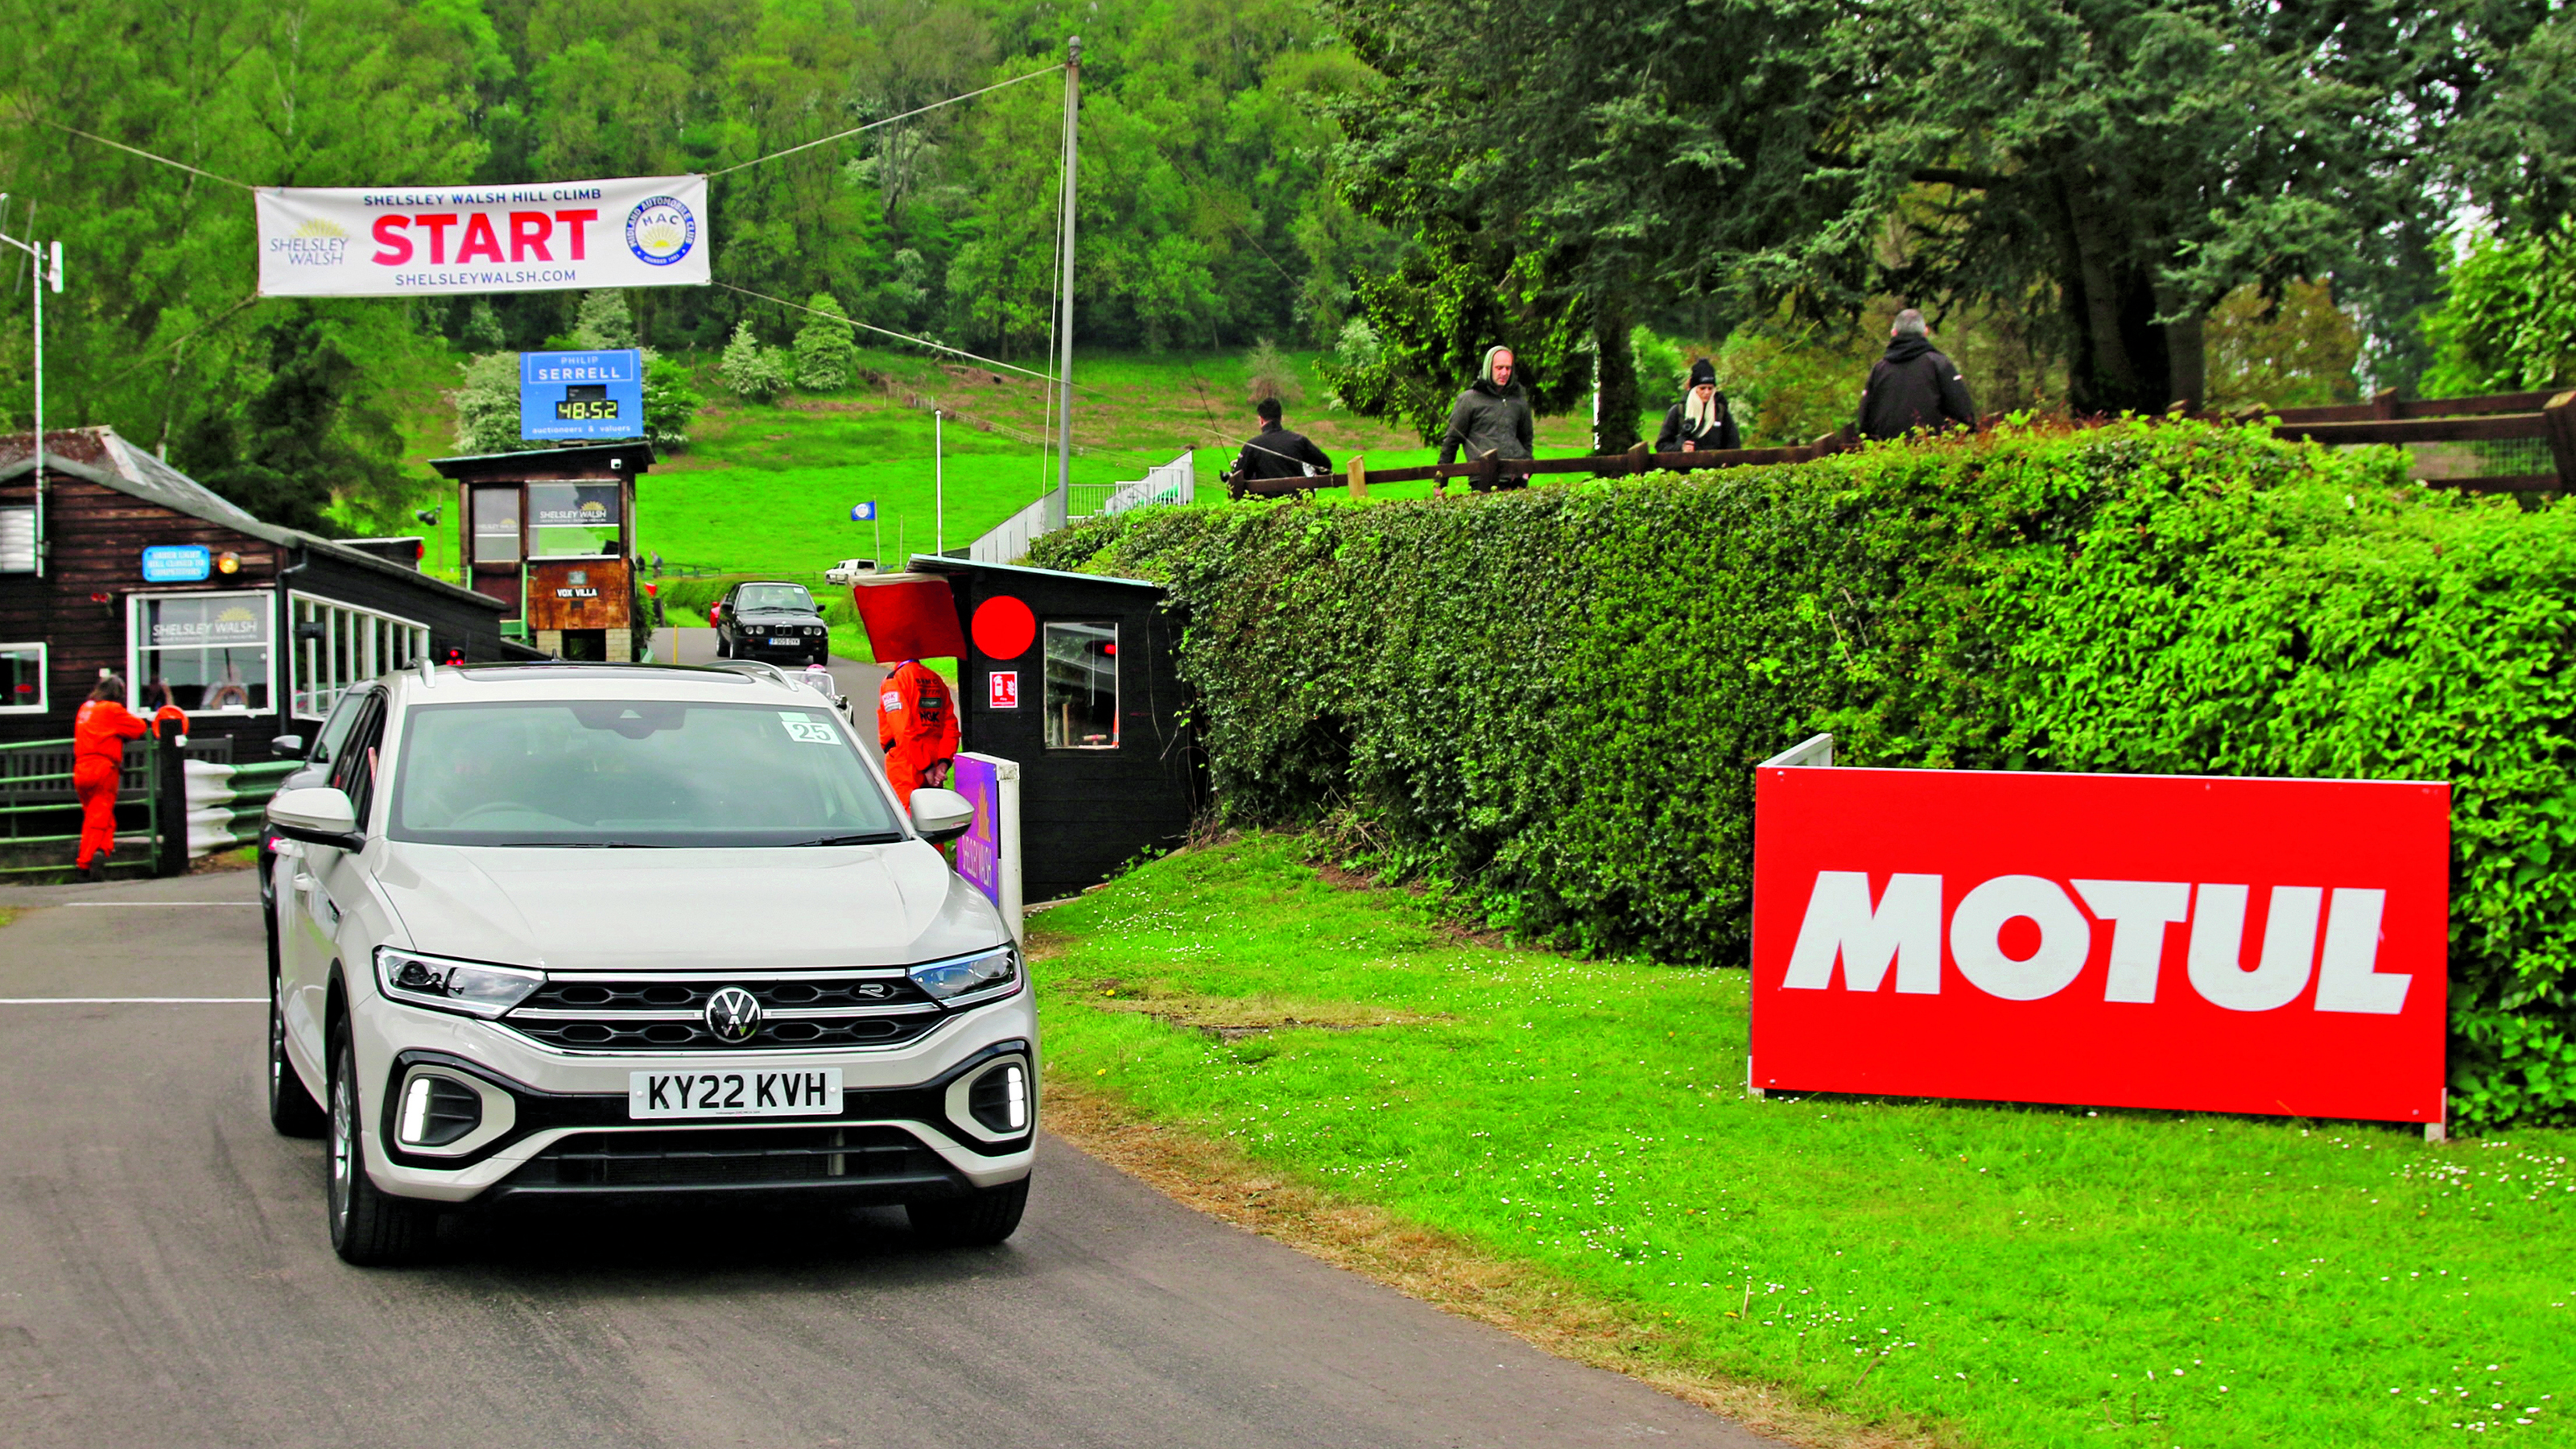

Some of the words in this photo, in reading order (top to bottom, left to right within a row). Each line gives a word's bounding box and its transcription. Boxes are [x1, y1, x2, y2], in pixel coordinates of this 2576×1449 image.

[364, 194, 444, 206] SHELSLEY
[452, 192, 506, 204] WALSH
[513, 191, 547, 202] HILL
[553, 188, 601, 200] CLIMB
[626, 208, 642, 249] MIDLAND
[642, 196, 691, 220] AUTOMOBILE
[685, 221, 695, 244] CLUB
[642, 213, 679, 226] MAC
[270, 237, 349, 252] SHELSLEY
[371, 208, 598, 266] START
[288, 251, 345, 265] WALSH
[395, 270, 576, 286] SHELSLEYWALSH.COM
[561, 356, 599, 365] PHILIP
[539, 367, 620, 380] SERRELL
[558, 402, 617, 419] 48.52
[600, 424, 631, 432] valuers
[539, 510, 578, 519] SHELSLEY
[579, 509, 607, 518] WALSH
[557, 588, 572, 597] VOX
[575, 588, 597, 597] VILLA
[152, 623, 213, 636] SHELSLEY
[214, 621, 258, 634] WALSH
[792, 724, 832, 741] 25
[1781, 870, 2413, 1015] MOTUL
[649, 1075, 744, 1110] KY22
[757, 1072, 825, 1108] KVH
